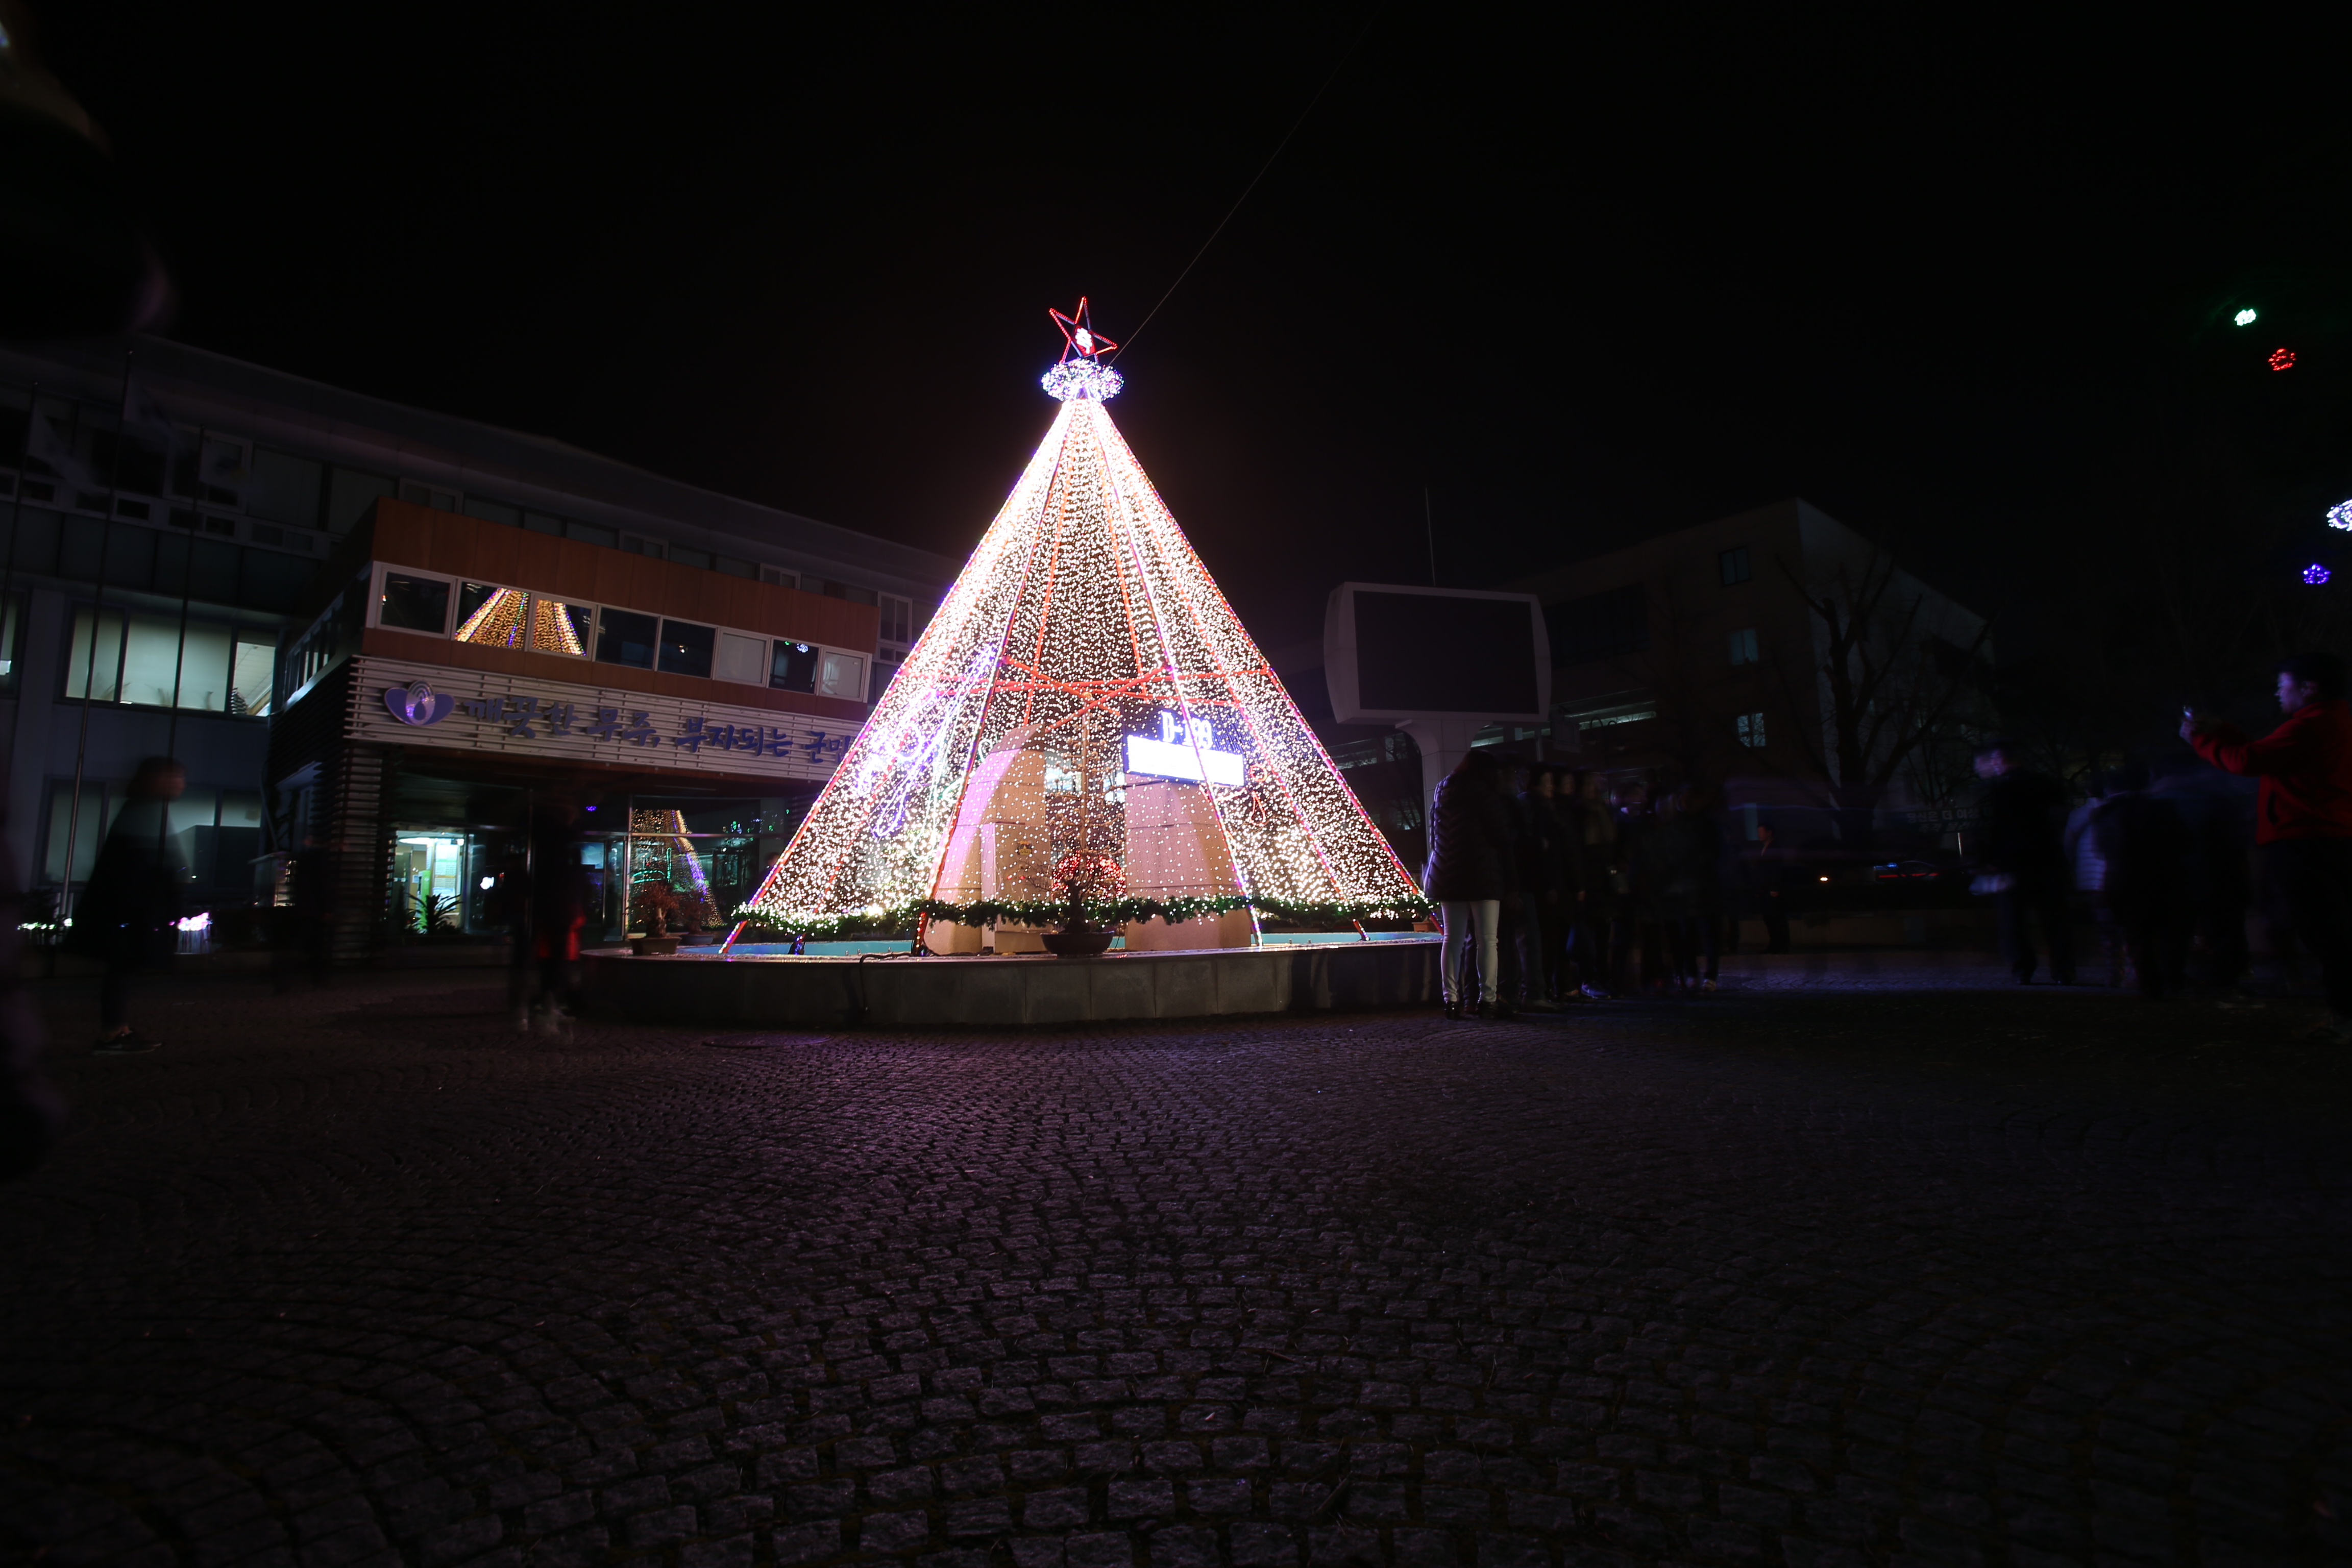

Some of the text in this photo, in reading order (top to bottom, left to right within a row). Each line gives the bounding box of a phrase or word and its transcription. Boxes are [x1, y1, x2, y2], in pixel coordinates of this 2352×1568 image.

[463, 697, 579, 739] 깨끗한
[587, 708, 660, 747] 무주,
[676, 717, 793, 757] 부자되는
